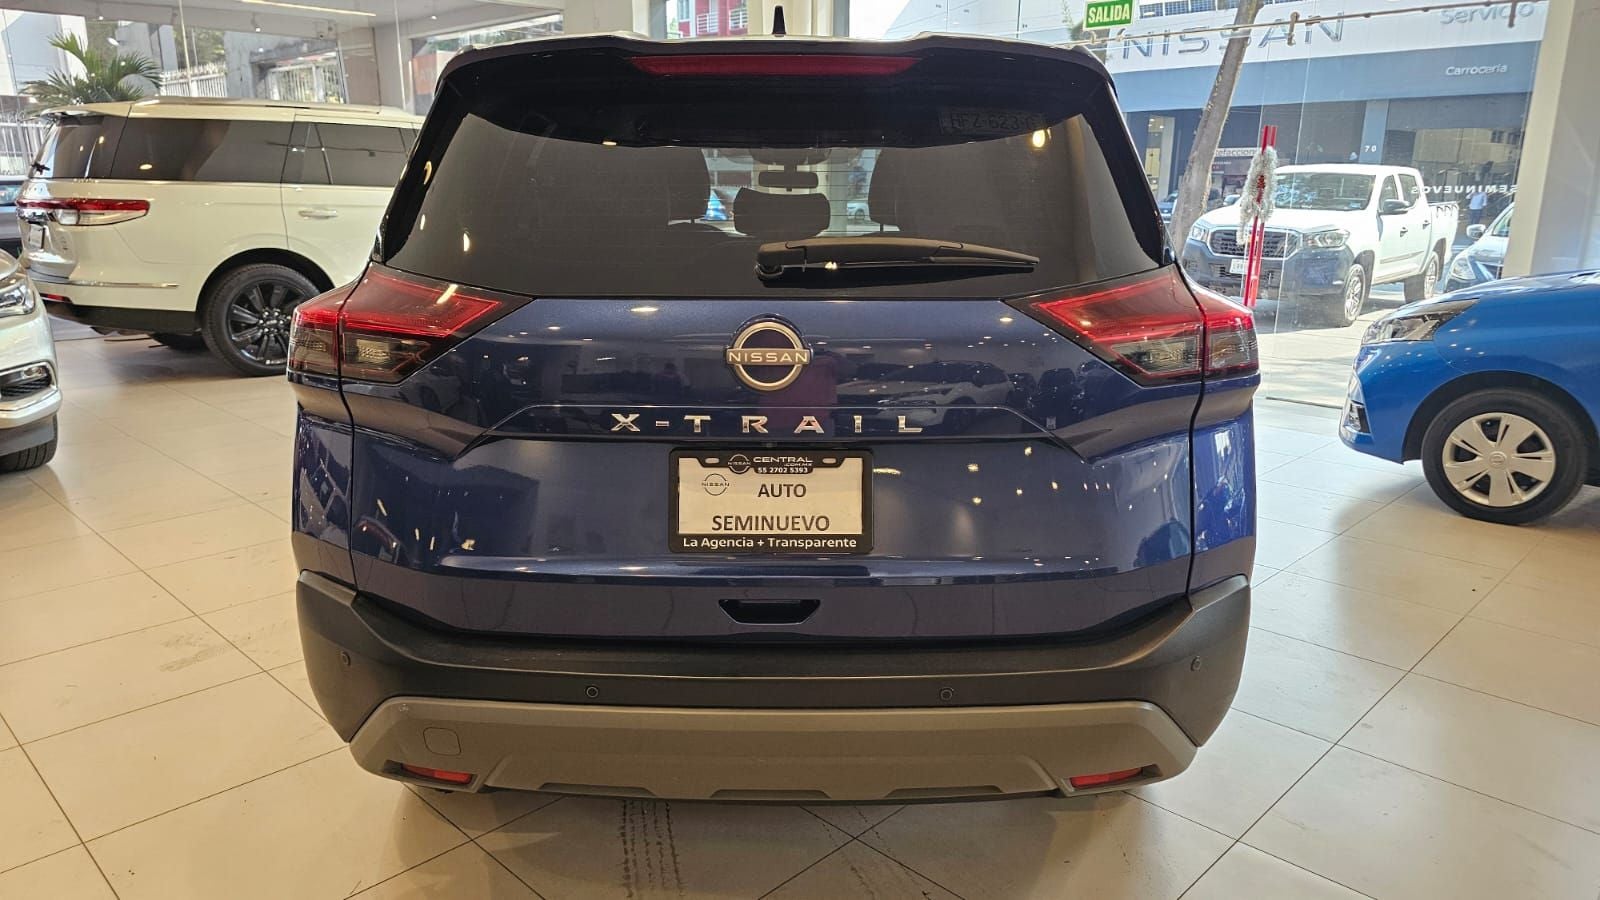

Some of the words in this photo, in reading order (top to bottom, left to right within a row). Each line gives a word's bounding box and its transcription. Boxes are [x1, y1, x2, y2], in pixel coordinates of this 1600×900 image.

[1087, 3, 1131, 23] SALIDA
[1440, 3, 1535, 24] Servico
[1363, 145, 1377, 153] 70
[728, 352, 809, 364] NISSAN
[610, 413, 923, 434] X-TRAIL
[757, 483, 807, 498] AUTO
[712, 515, 830, 532] SEMINUEVO
[683, 537, 698, 548] La
[701, 537, 754, 550] Agencia
[757, 539, 765, 547] +
[767, 537, 857, 550] Transparente
